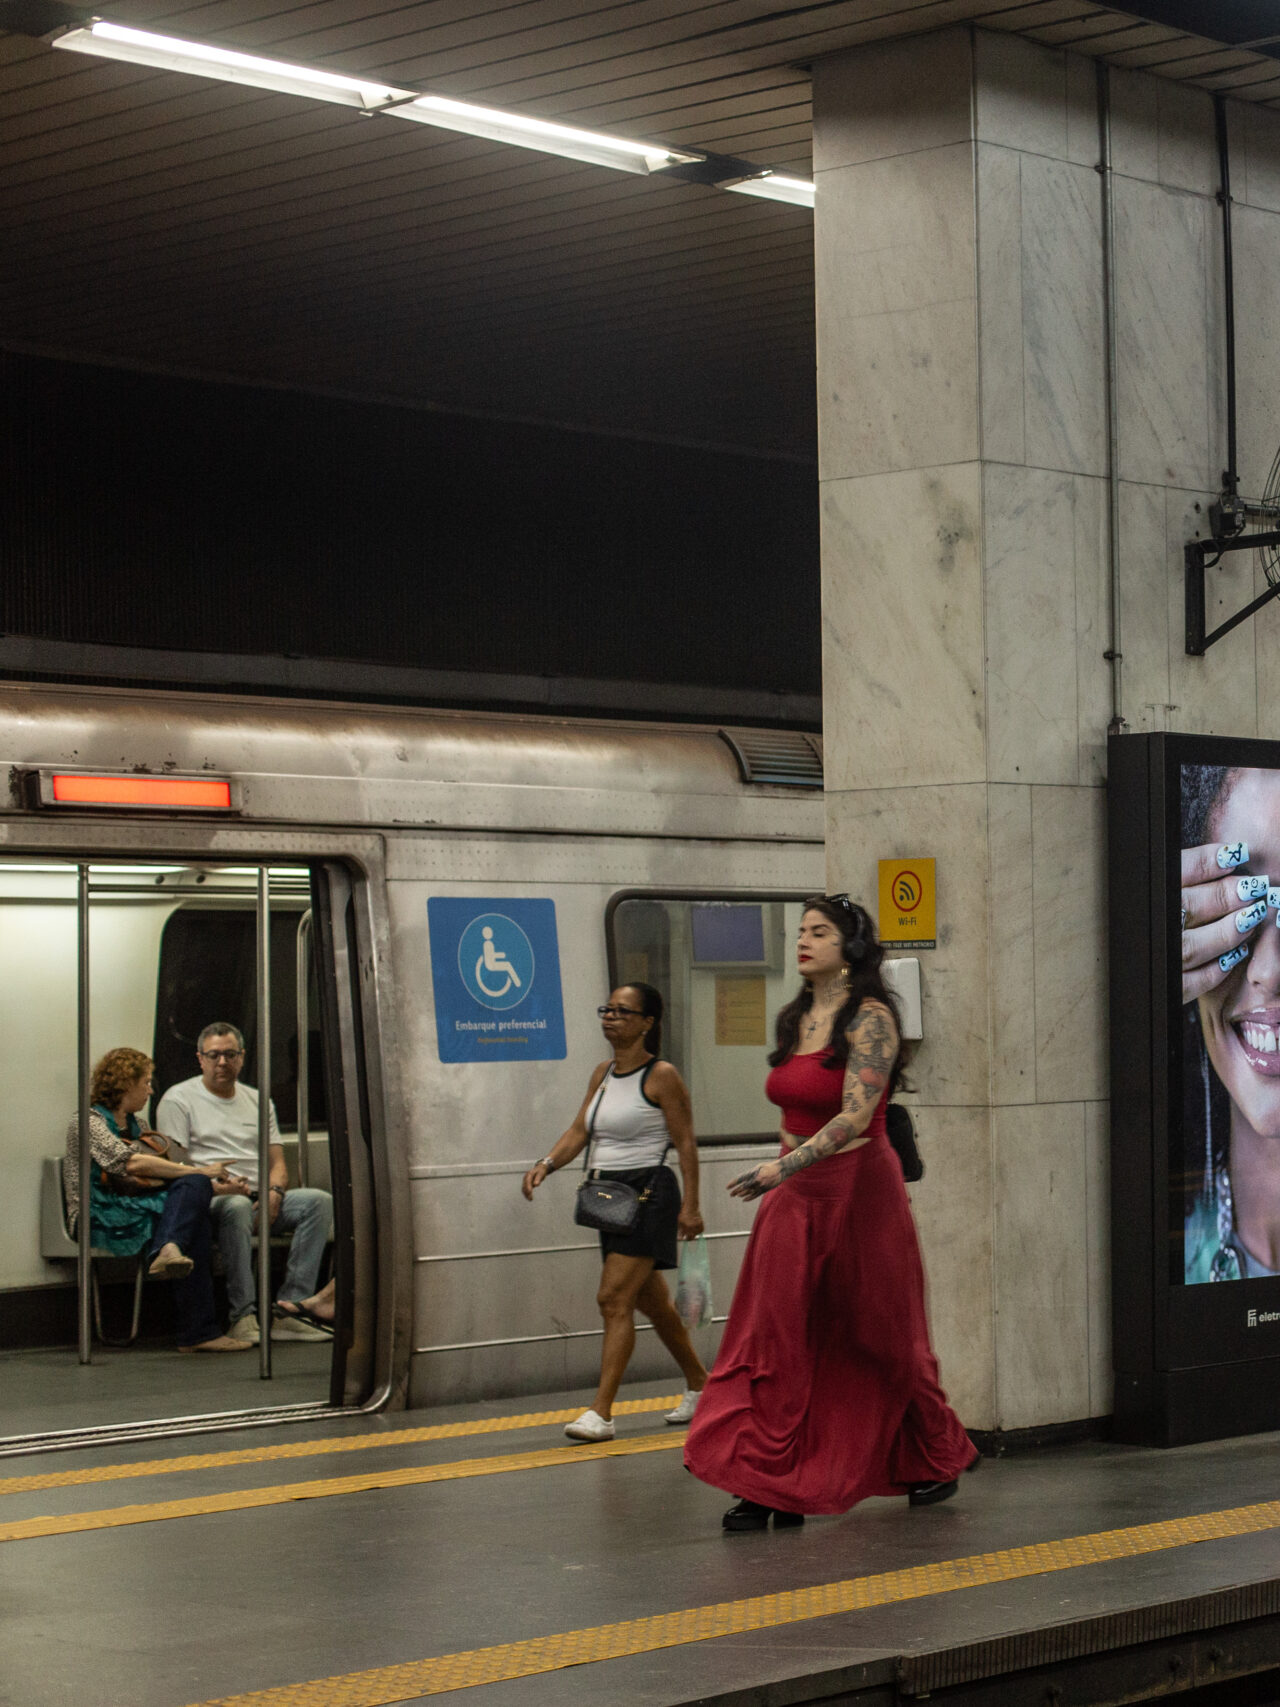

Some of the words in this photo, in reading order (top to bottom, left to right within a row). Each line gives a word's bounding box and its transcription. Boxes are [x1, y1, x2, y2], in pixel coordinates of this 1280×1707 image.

[898, 917, 917, 926] Wi-Fi
[455, 1020, 496, 1032] Embarque
[498, 1019, 547, 1032] preferencial
